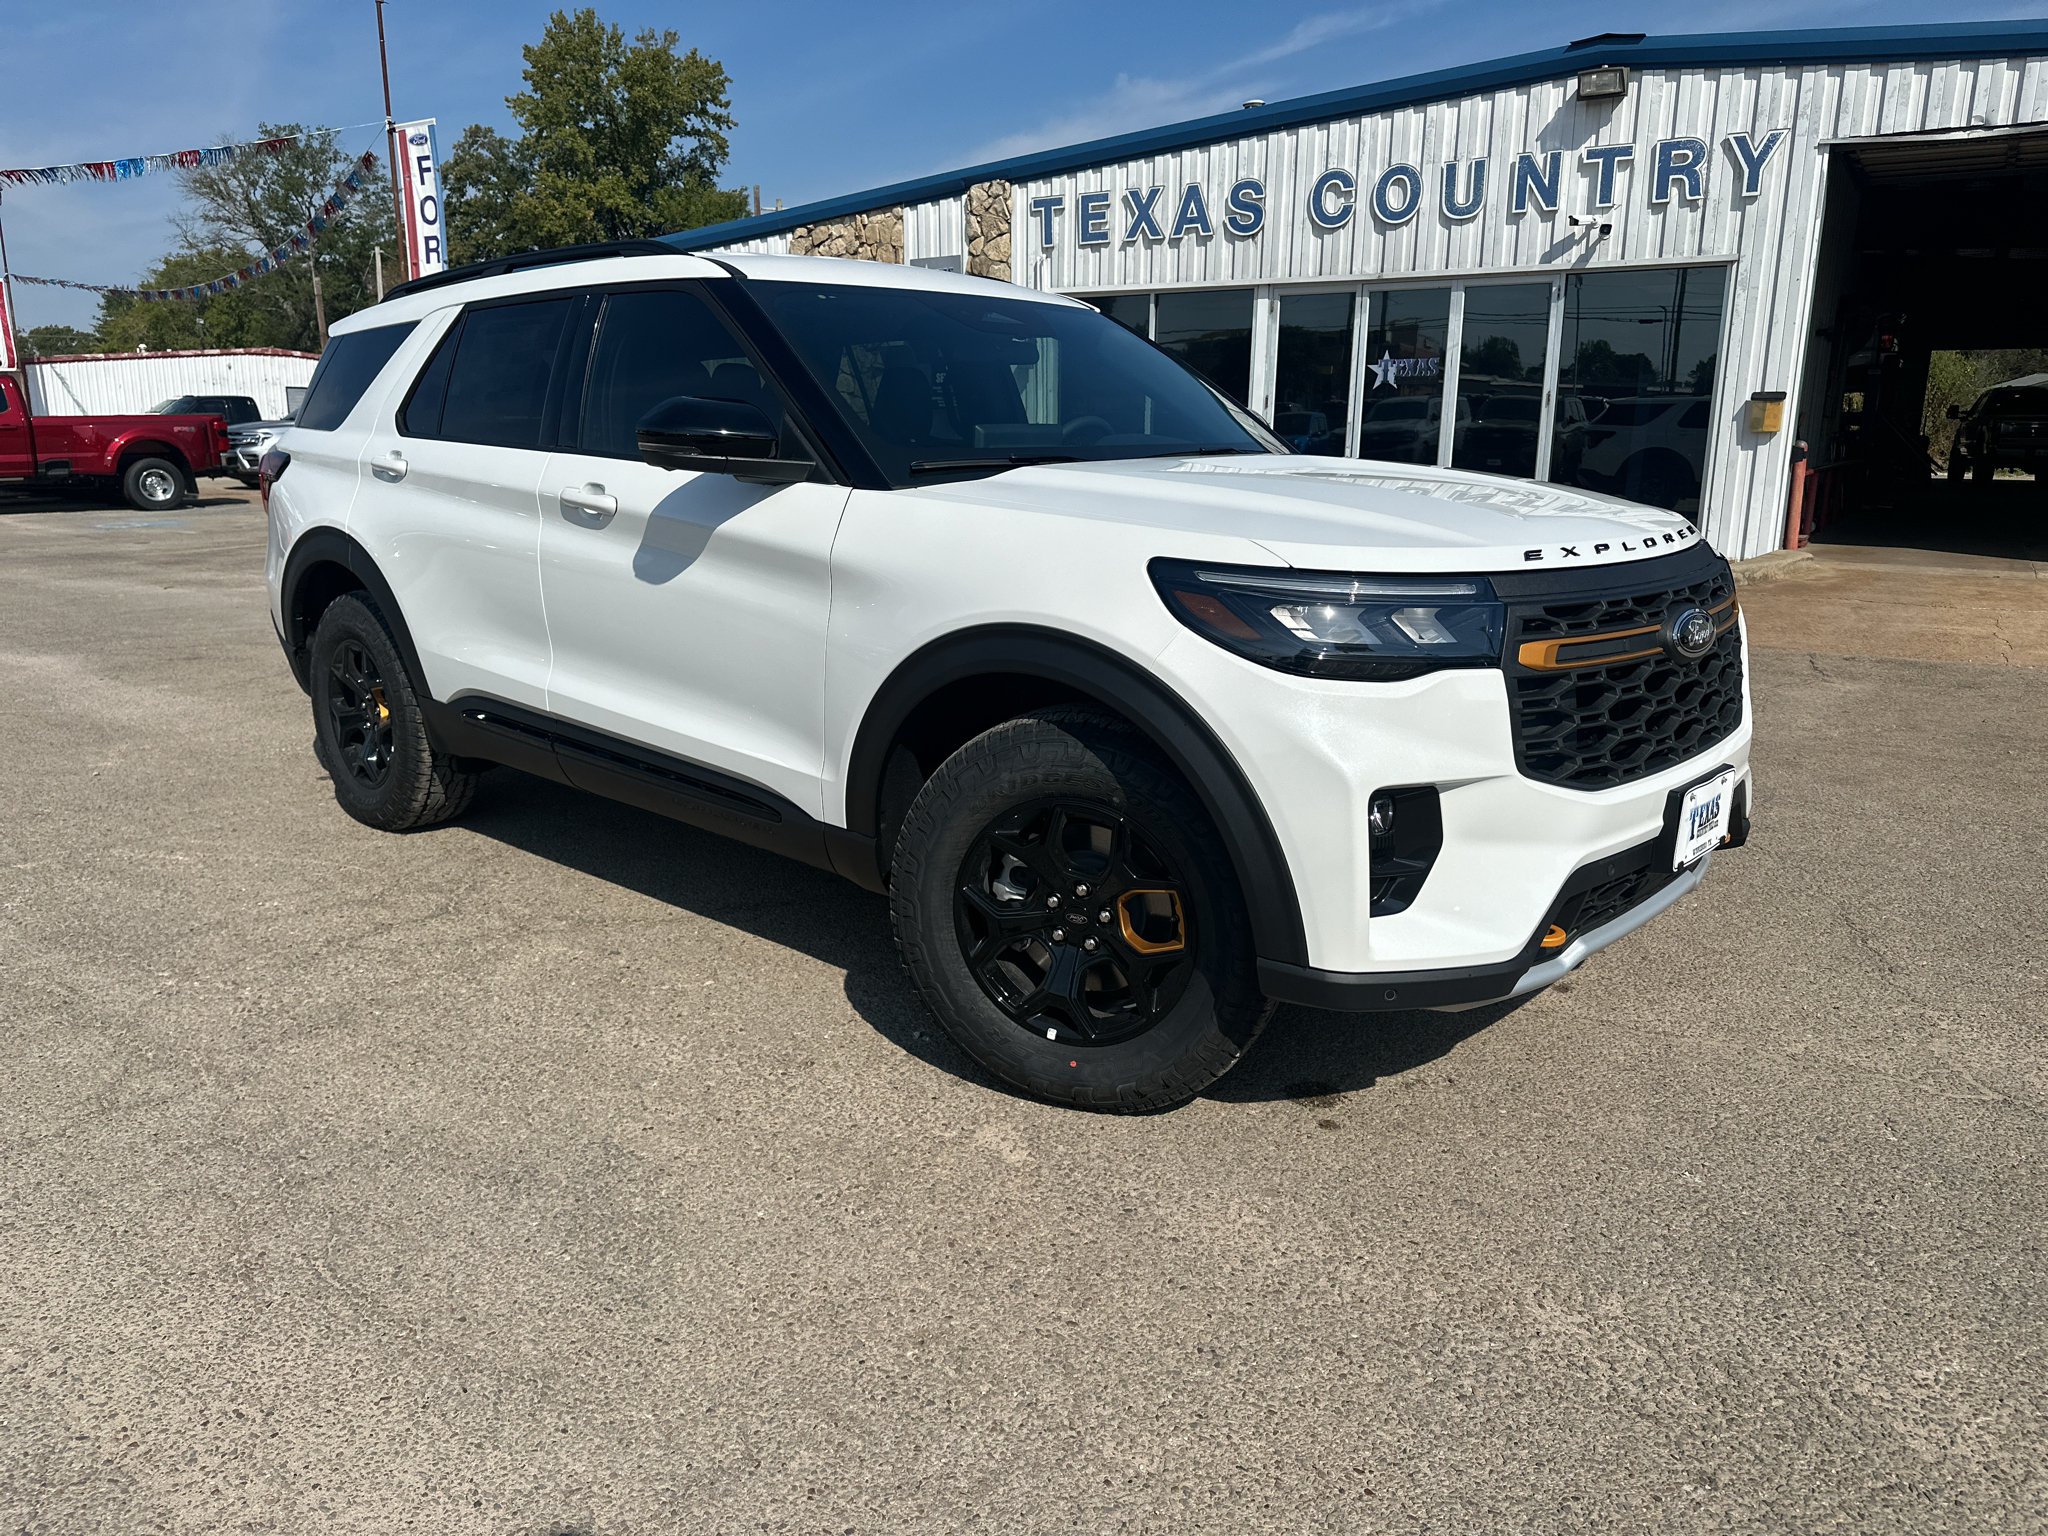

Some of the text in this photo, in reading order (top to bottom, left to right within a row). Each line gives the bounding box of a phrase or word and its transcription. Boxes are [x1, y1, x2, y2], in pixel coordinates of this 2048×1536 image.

[1031, 128, 1788, 247] TEXAS COUNTRY
[1378, 357, 1440, 384] TEXAS
[1689, 619, 1710, 646] Ford
[672, 798, 776, 836] EXPLORER
[967, 772, 1184, 839] BRIDGESTONE
[1690, 793, 1721, 841] TEXAS
